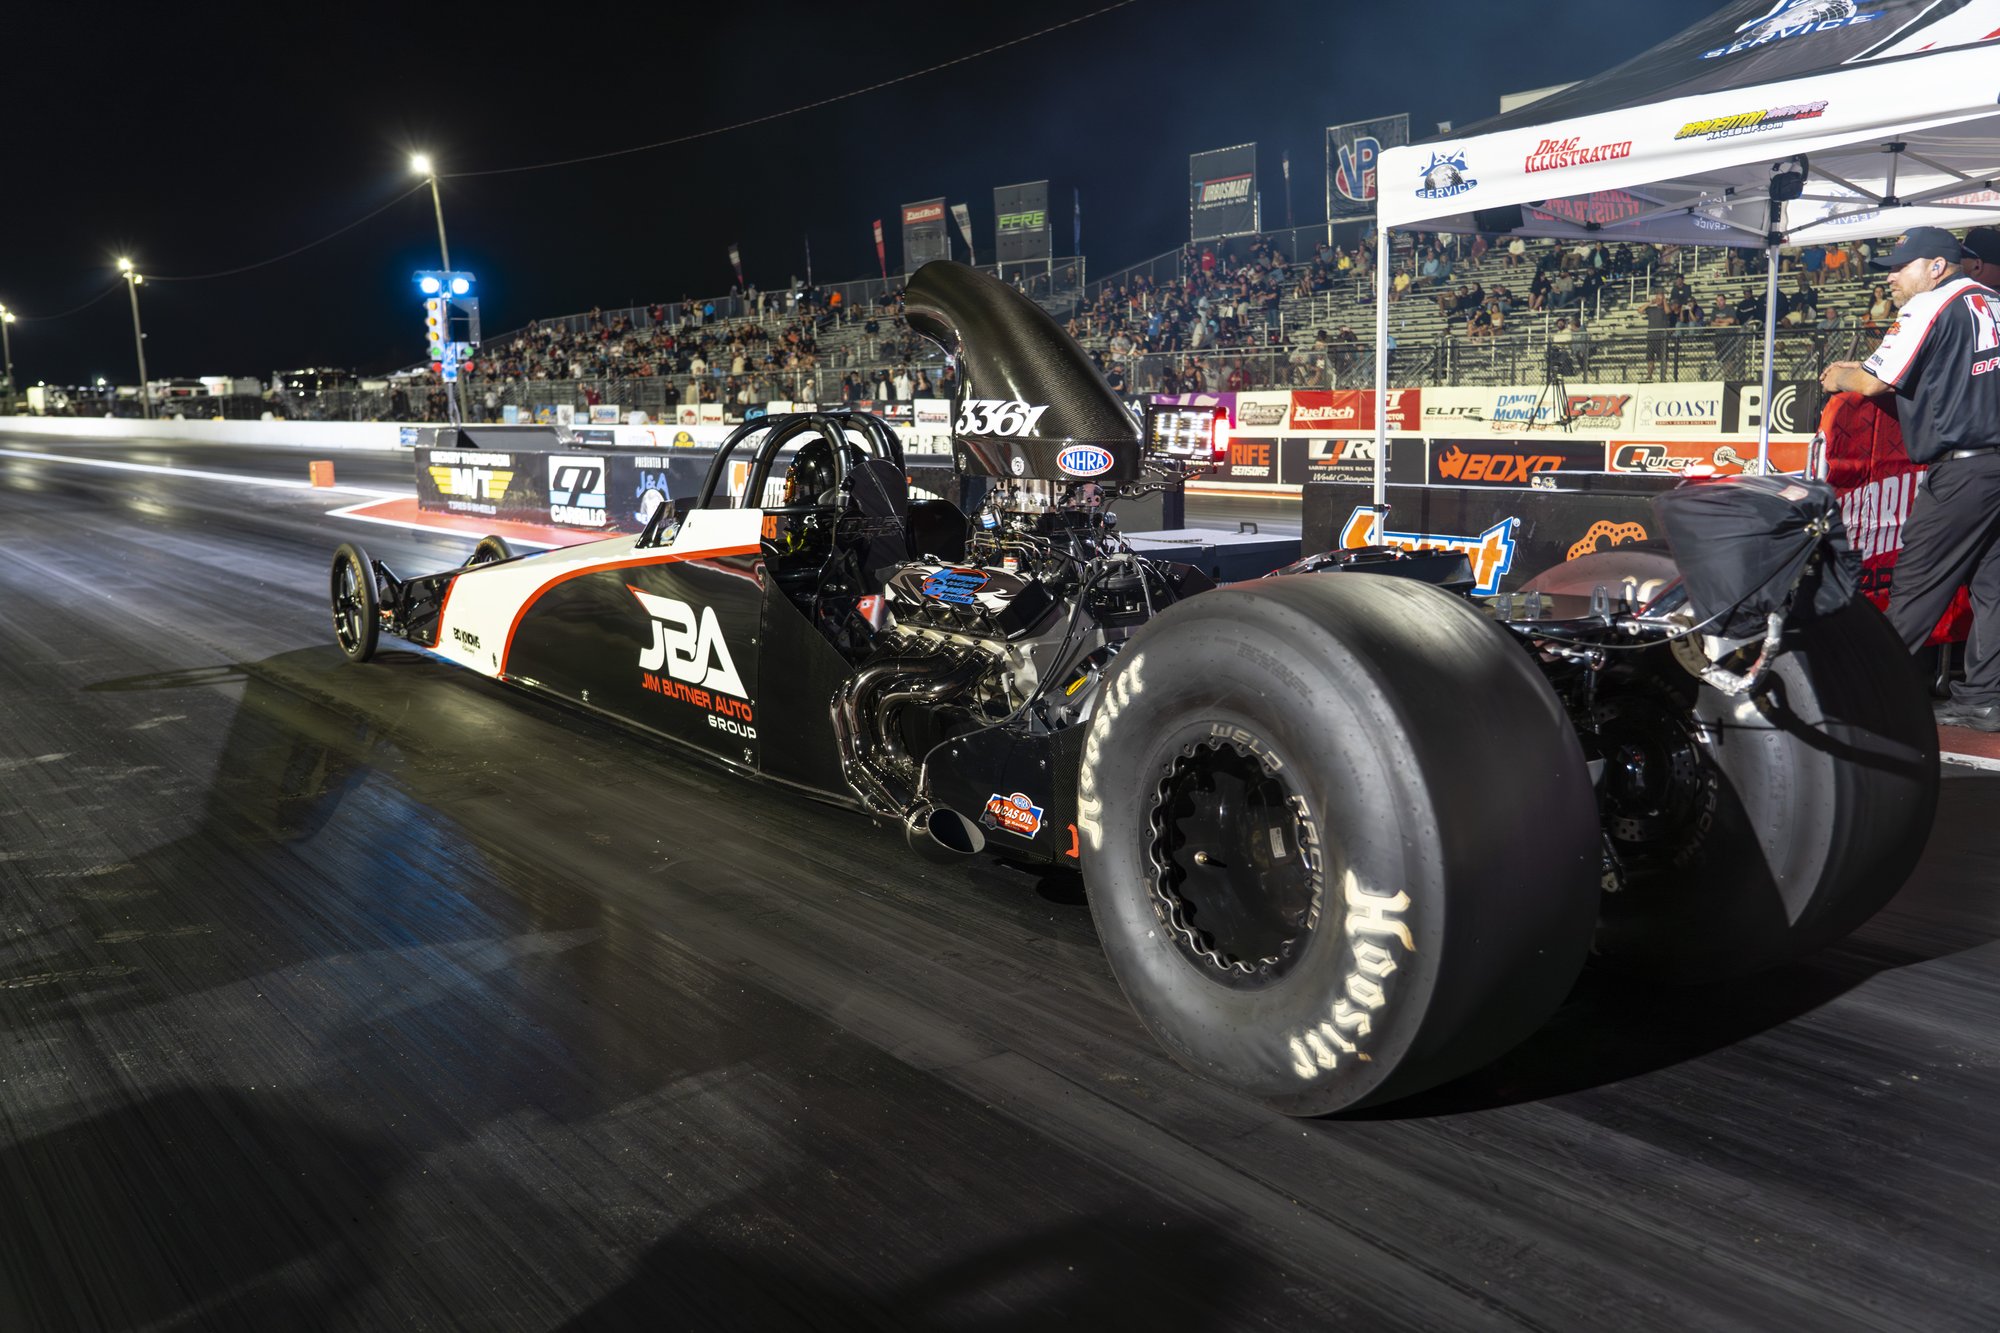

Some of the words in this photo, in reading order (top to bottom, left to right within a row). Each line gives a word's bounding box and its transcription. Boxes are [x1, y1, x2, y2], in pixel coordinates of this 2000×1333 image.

[1704, 14, 1875, 59] SERVICE
[1706, 122, 1783, 141] RACEBMP.com
[1524, 141, 1633, 173] ILLUSTRATED
[1533, 136, 1581, 157] DRAG
[1418, 147, 1469, 177] J&A
[1417, 181, 1478, 199] SERVICE
[1426, 407, 1482, 415] ELITE
[1497, 395, 1537, 407] DAVID
[1656, 400, 1719, 417] COAST
[1293, 406, 1356, 421] FuelTech
[1494, 407, 1551, 421] MUNDAY
[1066, 451, 1105, 470] NHRA
[1231, 444, 1271, 465] RIFE
[1230, 466, 1270, 478] SENSORS
[636, 471, 670, 501] J&A
[551, 505, 606, 528] CARRILLO
[642, 673, 661, 692] JIM
[662, 677, 713, 709] BUTNER
[715, 694, 754, 722] AUTO
[708, 714, 758, 740] GROUP
[1212, 723, 1283, 771] WELD
[990, 802, 1019, 819] LUCAS
[1018, 811, 1033, 825] OIL
[1291, 795, 1322, 933] RACING
[1290, 869, 1417, 1080] Hoosier
